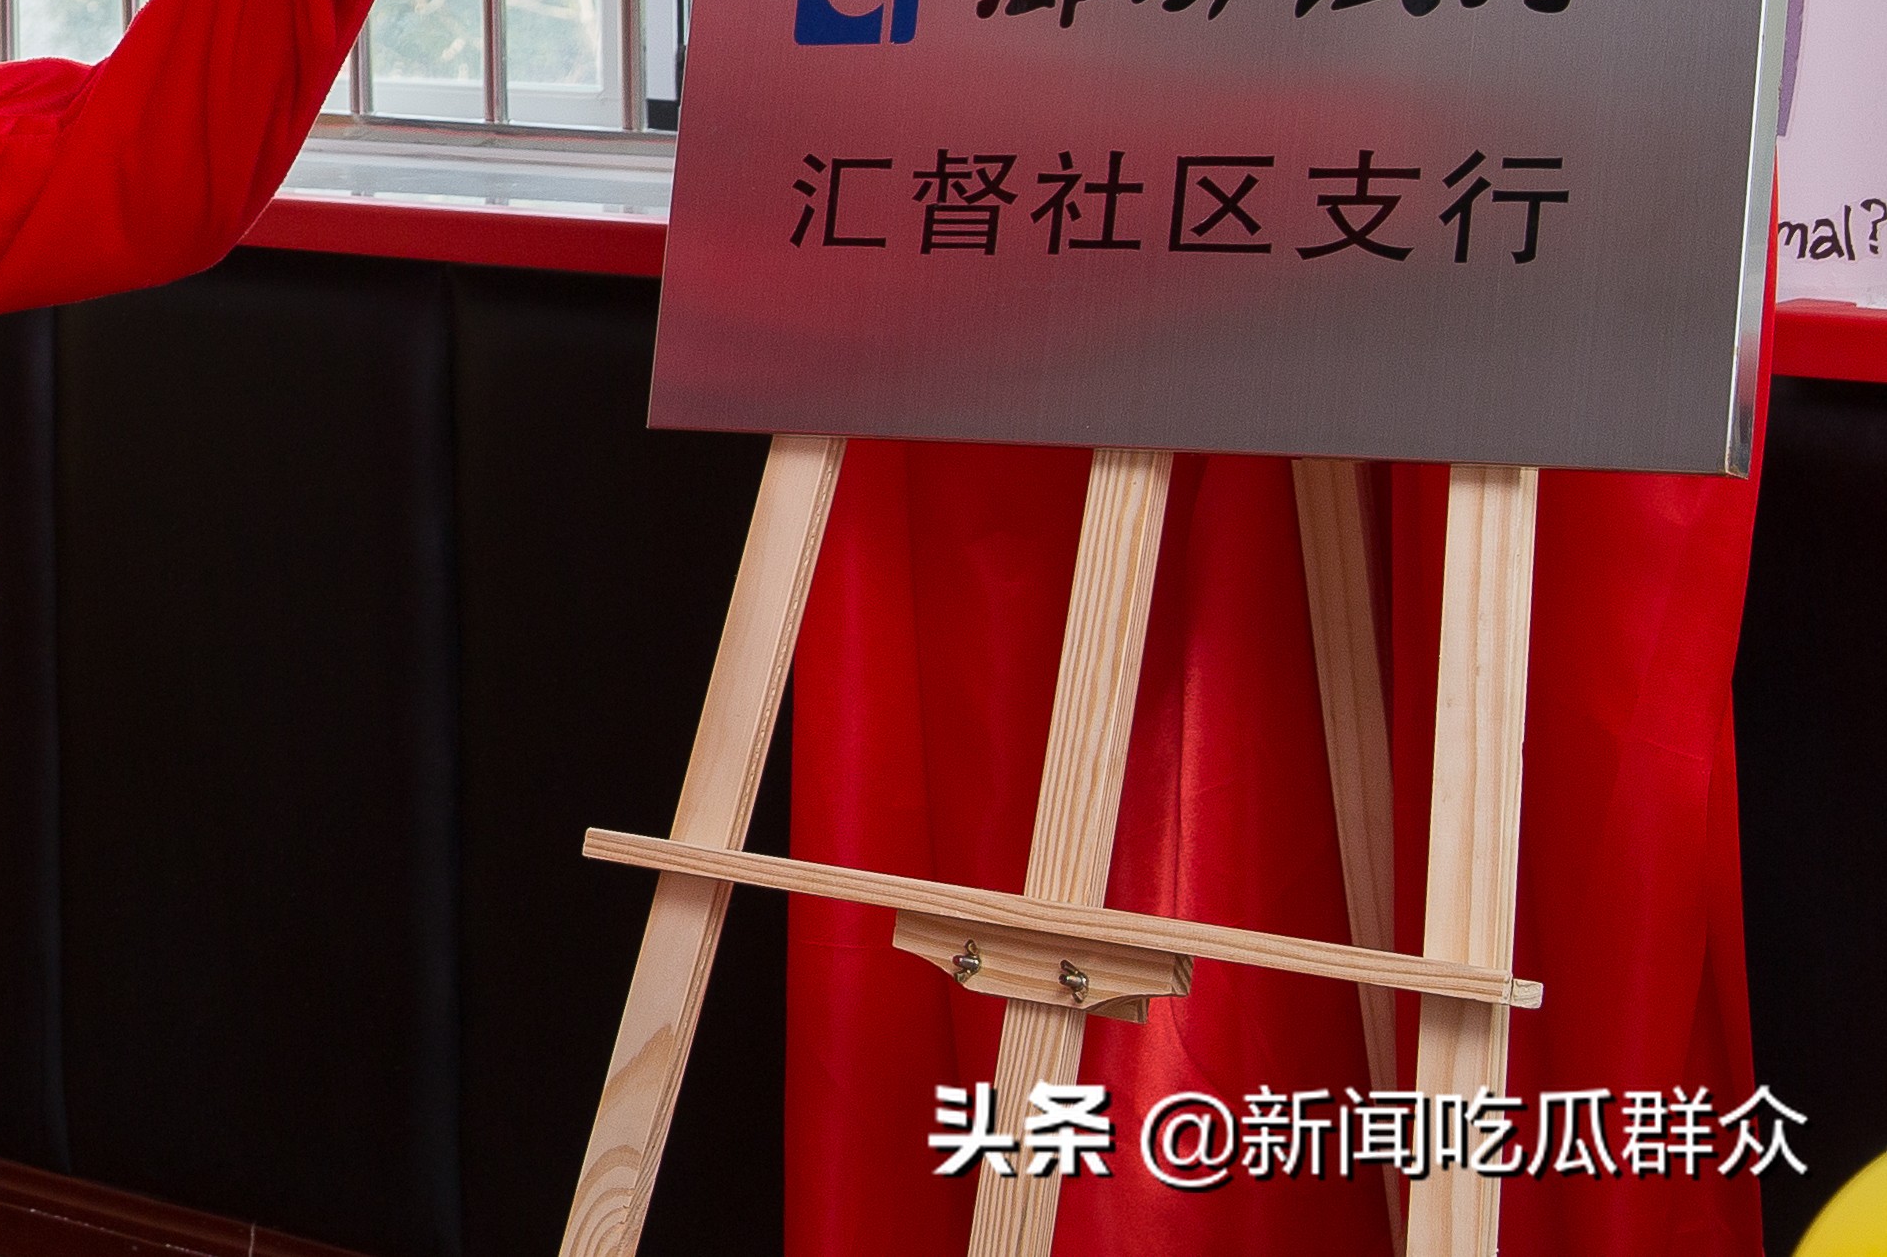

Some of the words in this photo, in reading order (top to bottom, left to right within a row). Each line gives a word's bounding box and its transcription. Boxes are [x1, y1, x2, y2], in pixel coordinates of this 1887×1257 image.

[788, 149, 1571, 265] 汇督社区支行
